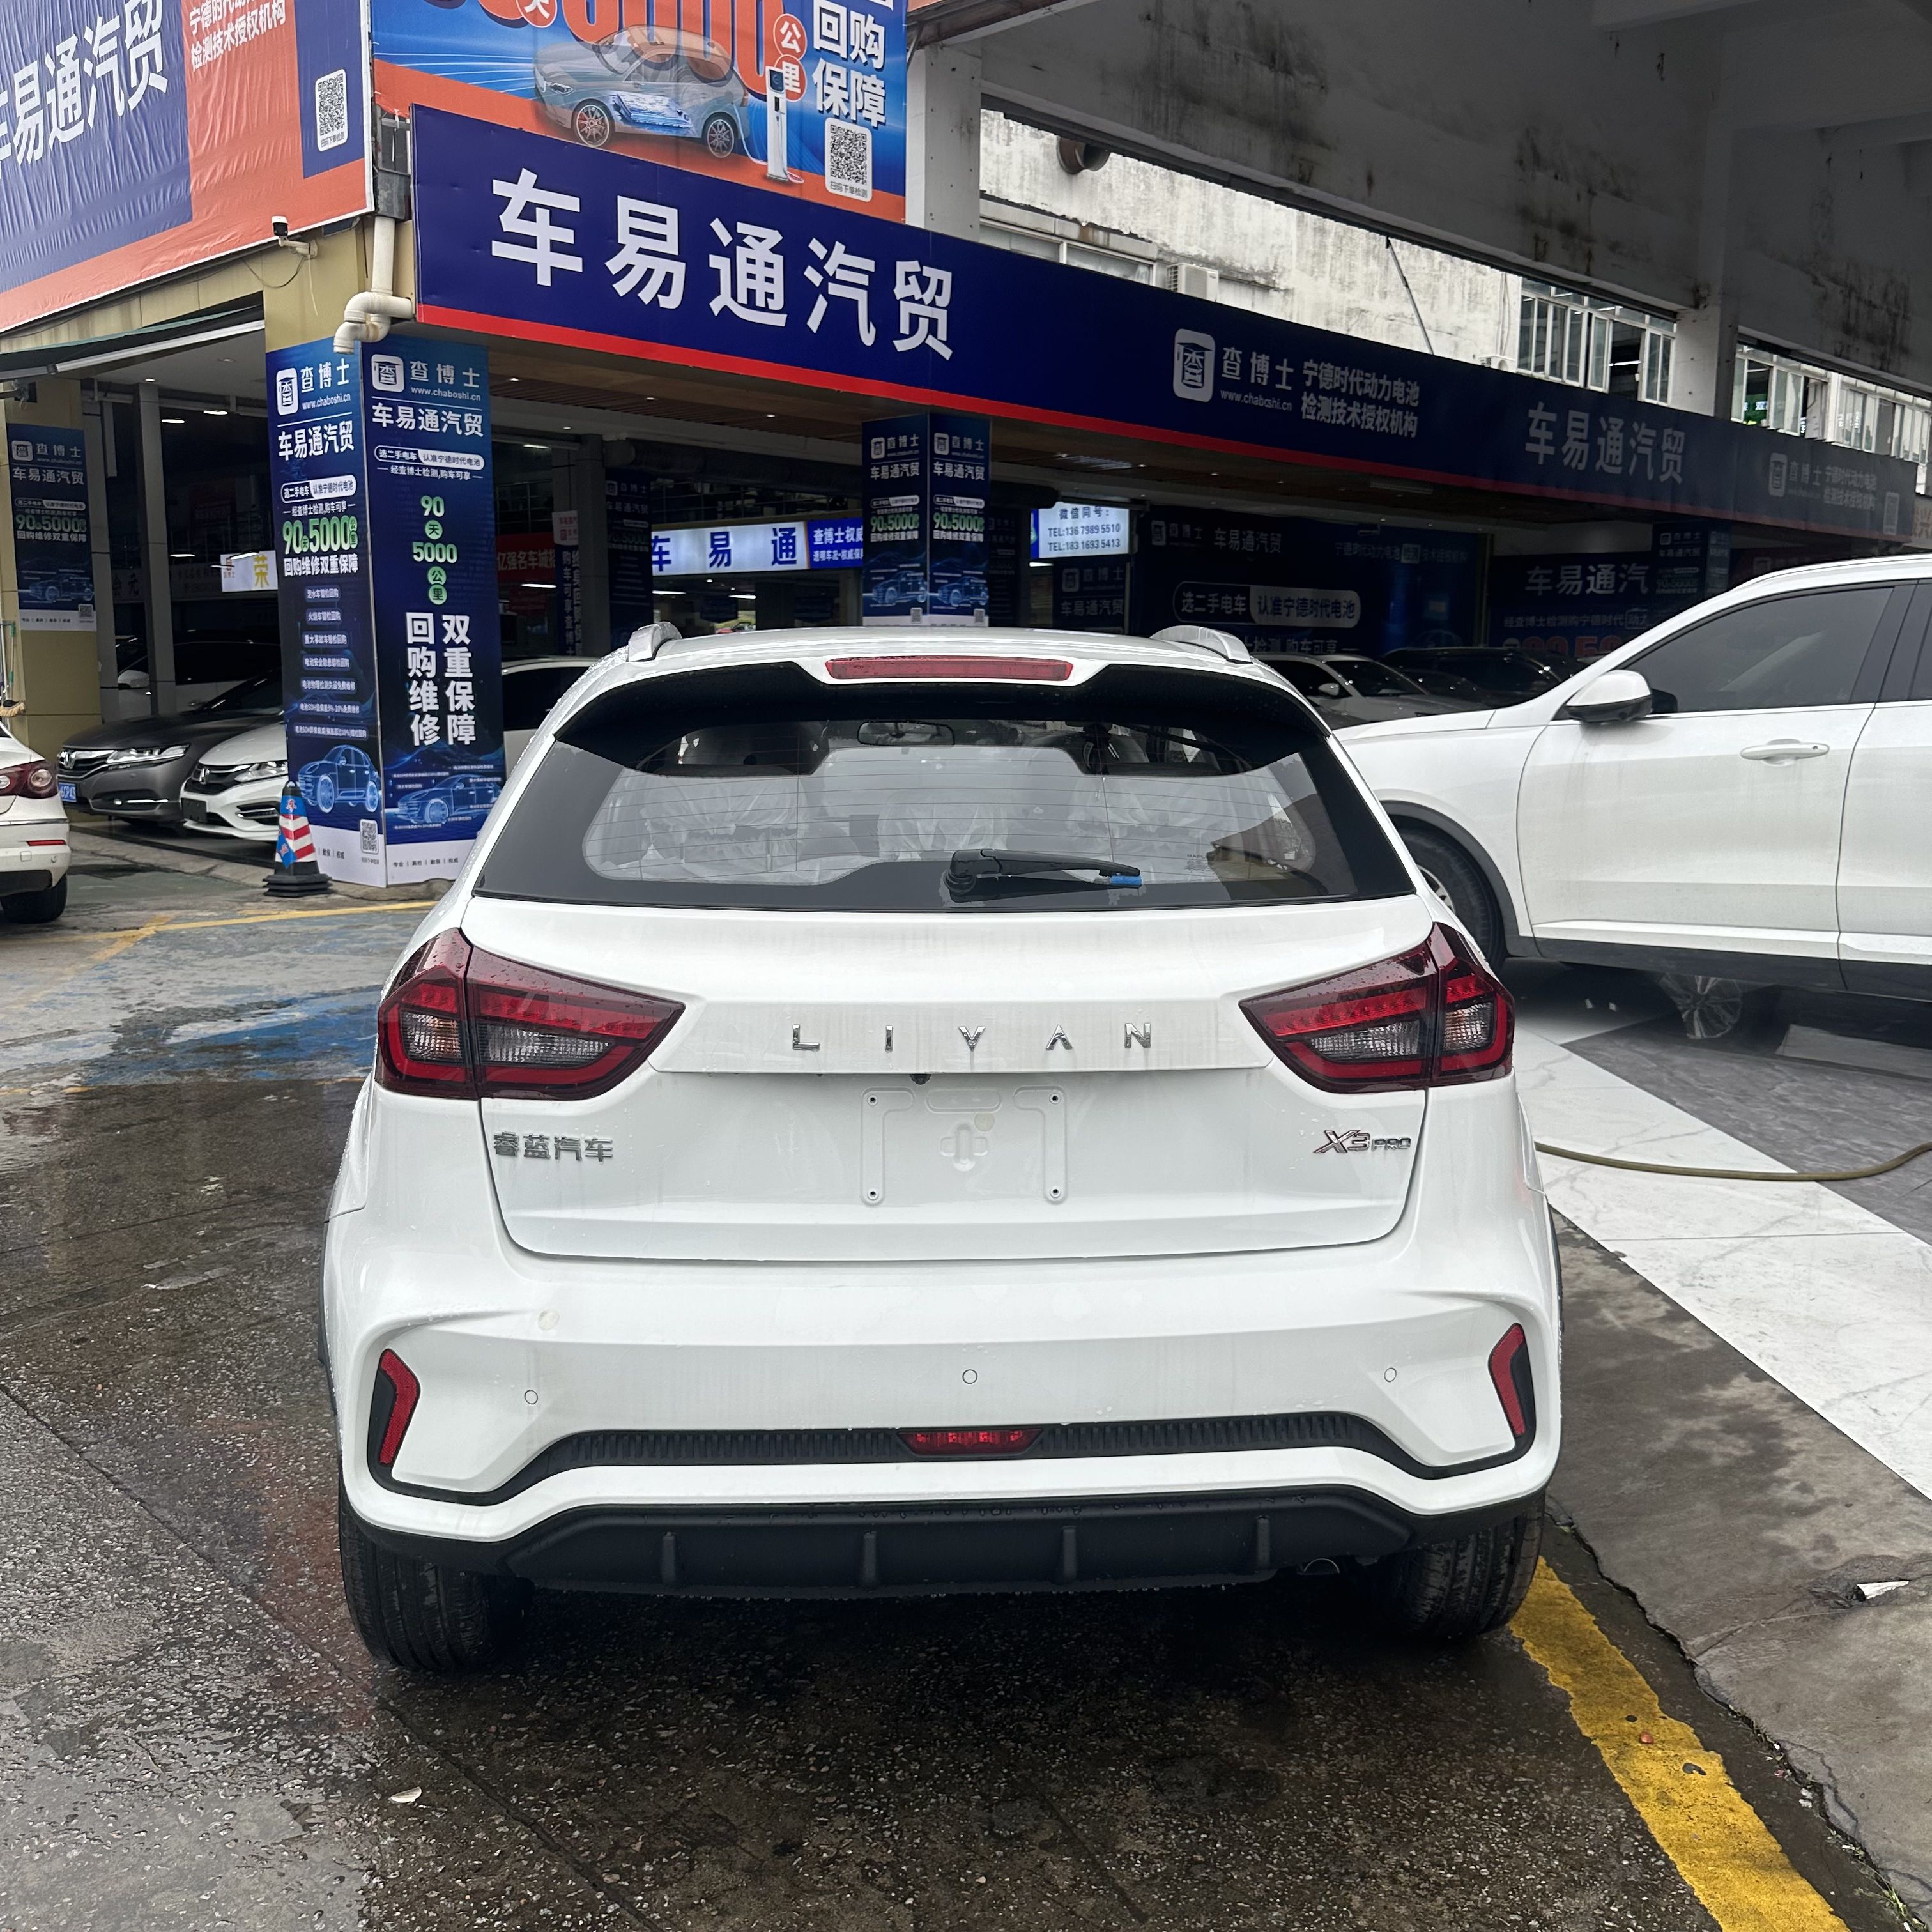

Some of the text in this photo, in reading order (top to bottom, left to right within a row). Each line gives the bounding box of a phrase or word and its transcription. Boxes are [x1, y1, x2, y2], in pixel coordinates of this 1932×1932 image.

[191, 0, 286, 72] 检测技术授权机构
[813, 1, 885, 68] 回购
[812, 58, 885, 127] 保障
[491, 168, 953, 360] 车易通汽贸
[301, 358, 349, 393] 查博士
[410, 361, 480, 388] 查博士
[1221, 346, 1294, 391] 查博士
[1302, 359, 1420, 407] 宁德时代动力电池
[302, 392, 351, 410] www.chaboshi.cn
[411, 387, 481, 401] www.chaboshi.cn
[1220, 389, 1292, 411] www.chaboshi.cn
[372, 402, 484, 437] 车易通汽贸
[1301, 391, 1418, 438] 检测技术授权机构
[278, 420, 355, 461] 车易通汽贸
[1525, 401, 1685, 484] 车易通汽贸
[13, 466, 84, 486] 车易通汽贸
[870, 461, 920, 480] 车易通汽贸
[933, 461, 985, 480] 车易通汽贸
[420, 495, 445, 517] 90
[1101, 524, 1121, 533] 5510
[1214, 527, 1283, 553] 车易通汽贸
[413, 542, 457, 564] 5000
[1101, 539, 1121, 549] 5413
[284, 553, 359, 577] 回购维修双重保障
[1524, 562, 1650, 596] 车易通汽
[1060, 599, 1124, 617] 车易通汽贸
[1181, 590, 1354, 619] 选二手电车 认准宁德时代电池
[406, 611, 441, 746] 回购维修
[442, 614, 477, 745] 双重保障
[493, 1130, 613, 1162] 睿蓝汽车
[1313, 1130, 1411, 1153] X3 PRO
